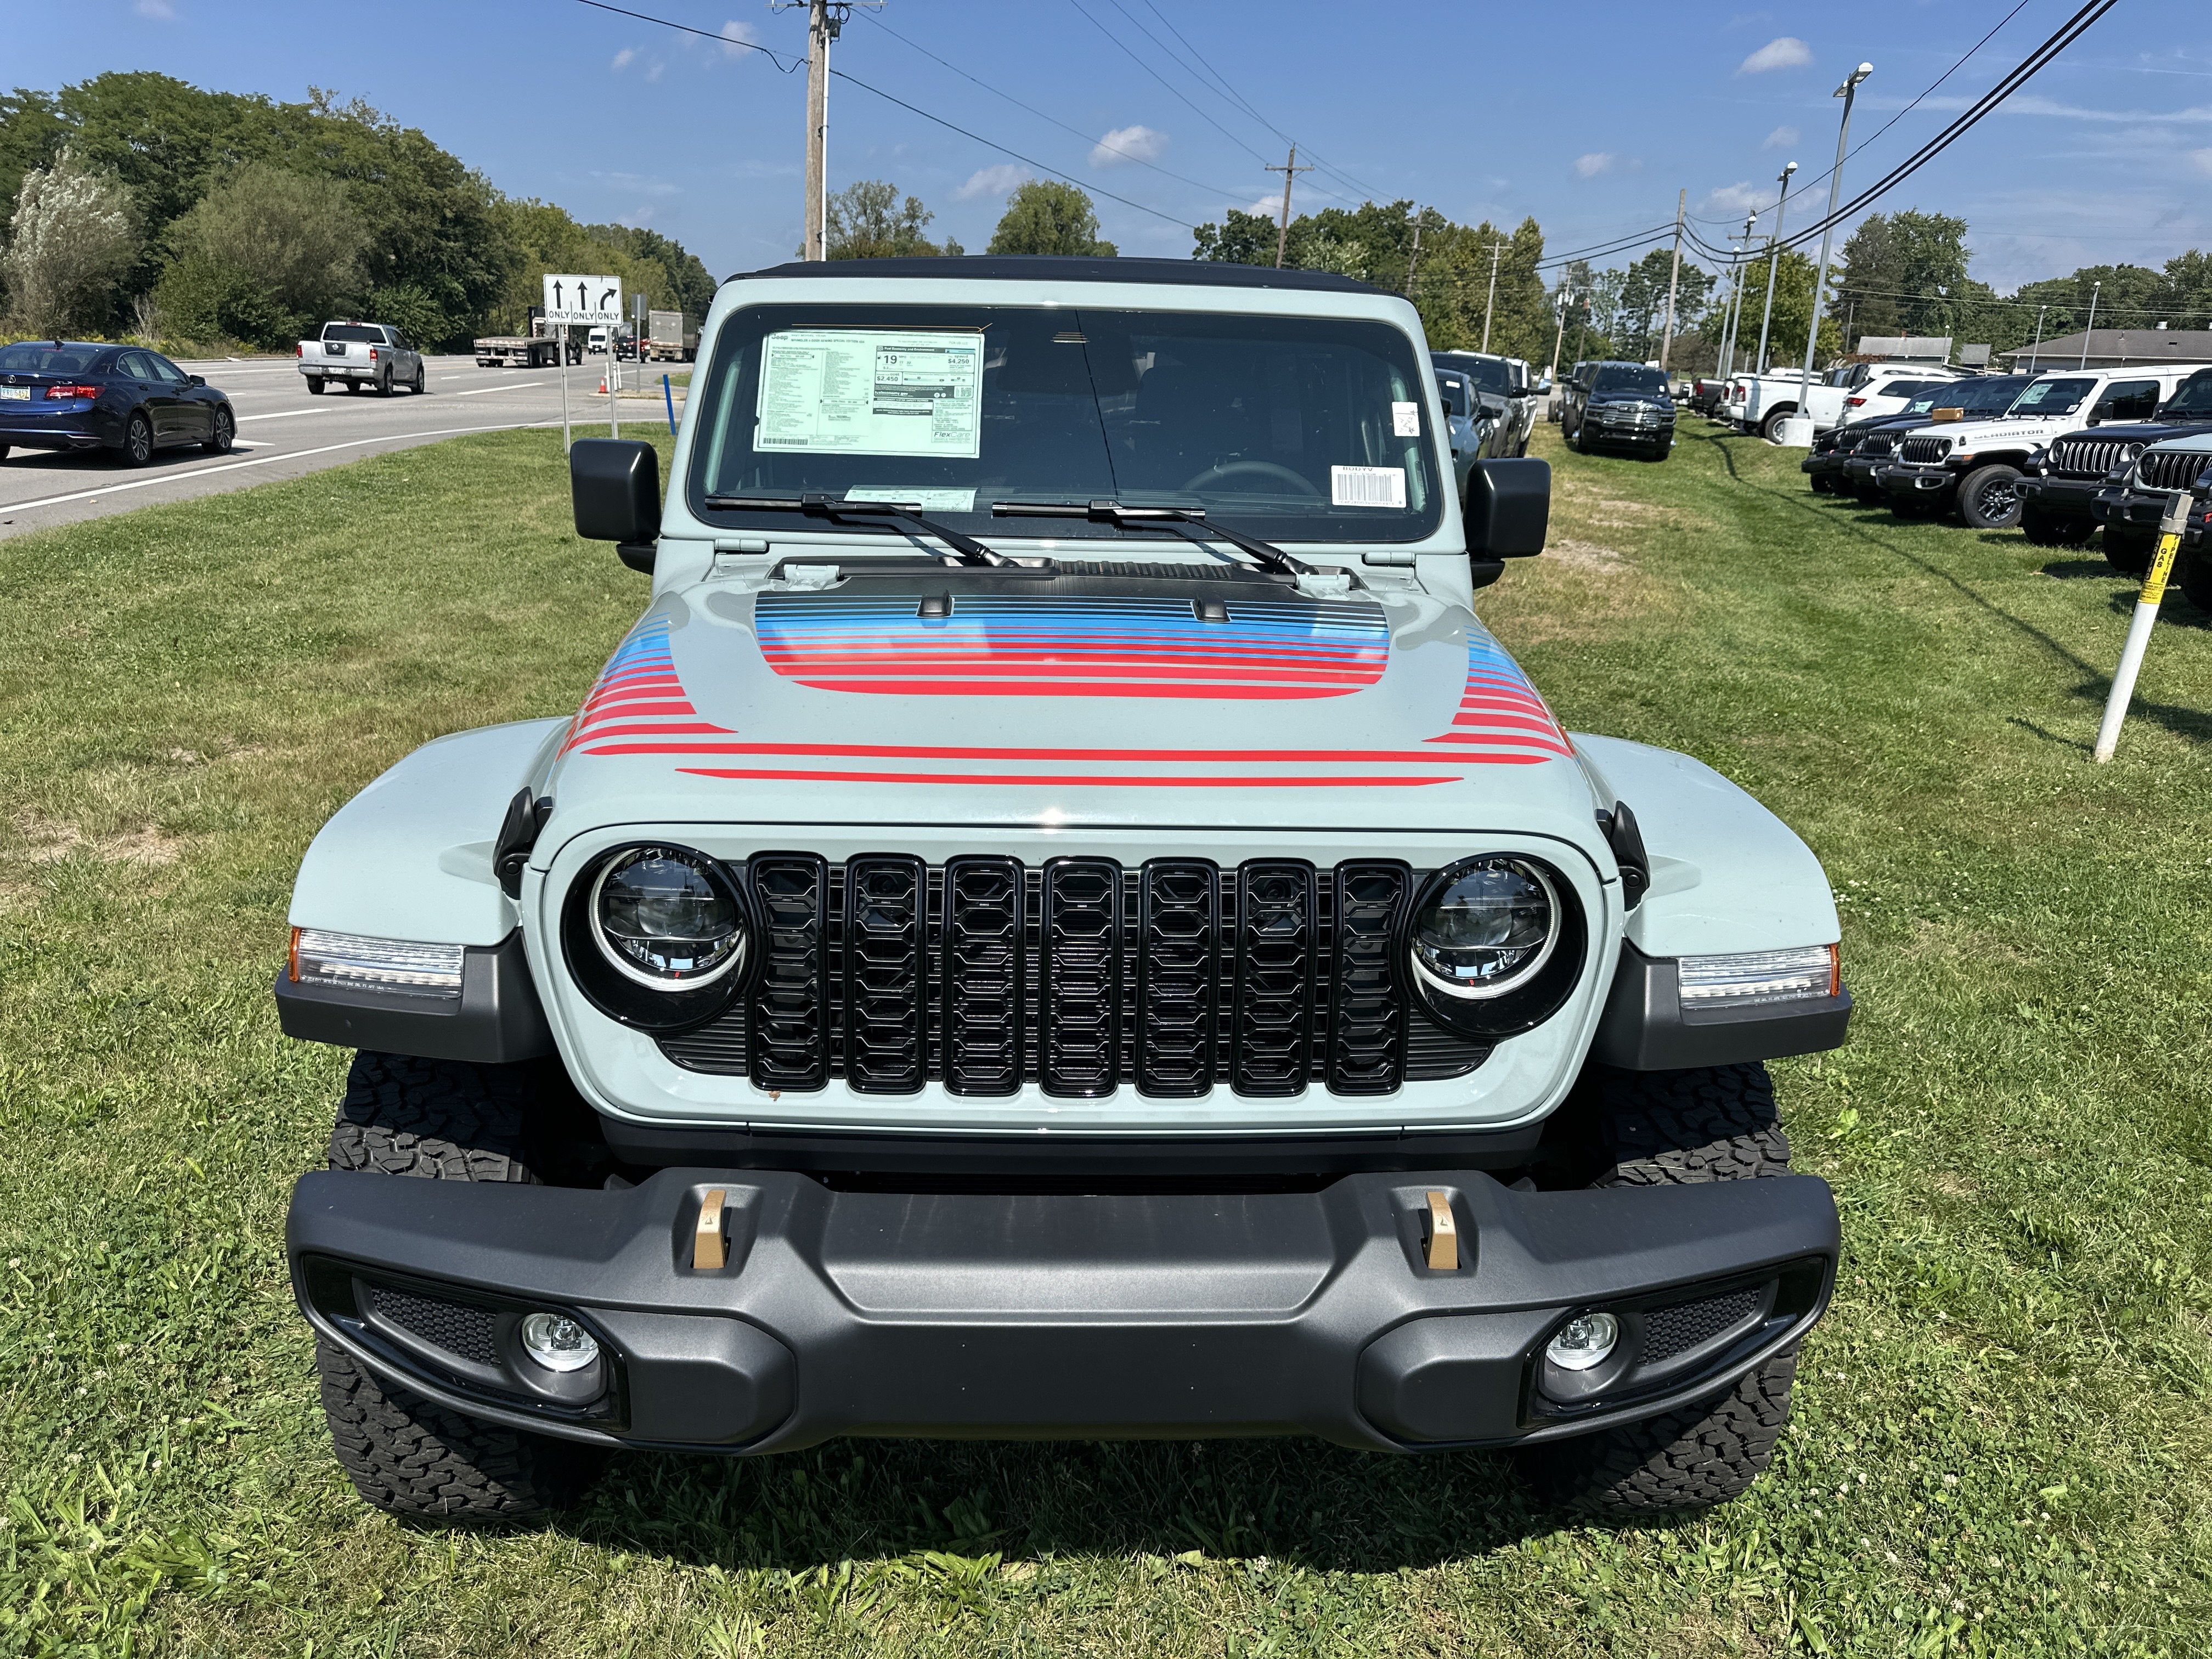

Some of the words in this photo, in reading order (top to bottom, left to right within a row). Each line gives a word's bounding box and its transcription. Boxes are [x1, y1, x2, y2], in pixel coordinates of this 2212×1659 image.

[549, 311, 570, 319] ONLY
[573, 312, 594, 320] ONLY
[884, 355, 897, 364] 19
[2146, 532, 2163, 579] WARNING
[2157, 548, 2168, 567] GAS
[2161, 535, 2179, 583] PIPELINE
